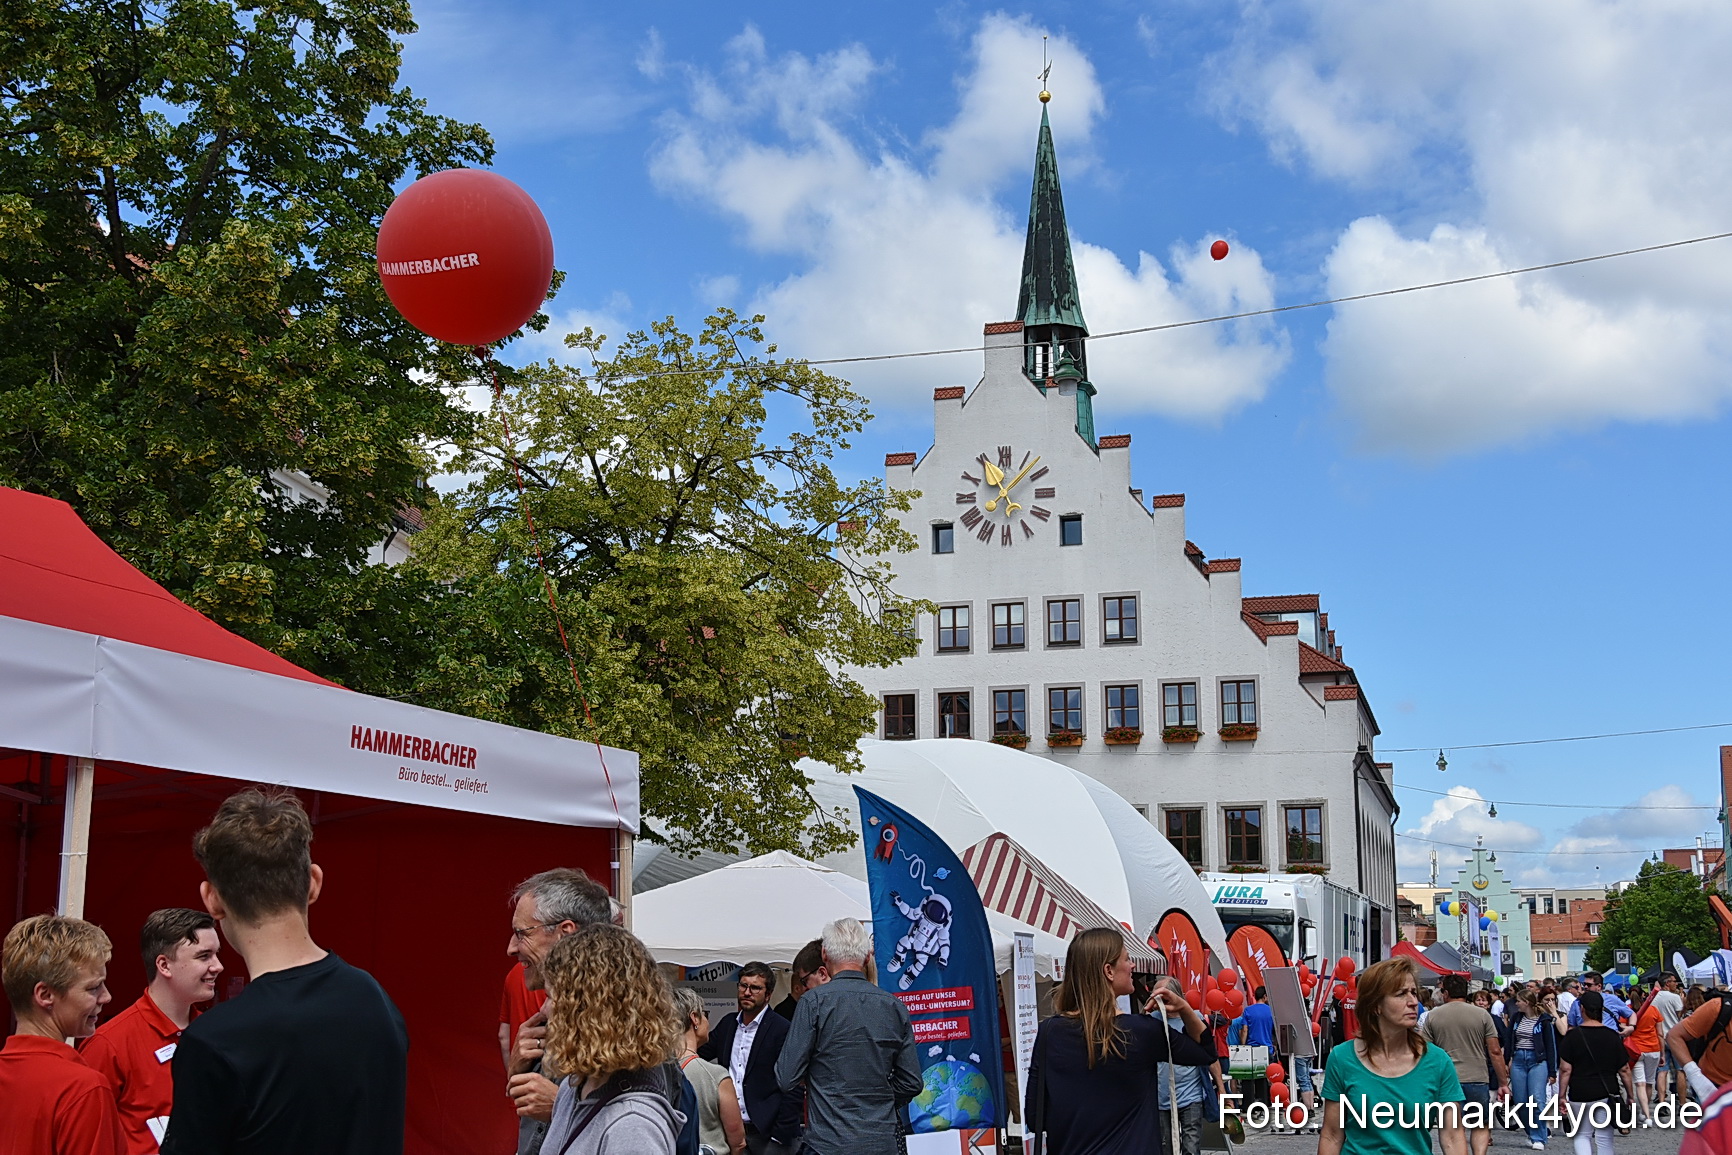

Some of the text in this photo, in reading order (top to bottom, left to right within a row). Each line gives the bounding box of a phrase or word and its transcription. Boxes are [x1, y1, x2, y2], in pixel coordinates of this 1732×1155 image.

[381, 253, 480, 275] HAMMERBACHER
[350, 724, 477, 770] HAMMERBACHER
[398, 766, 489, 794] Büro bestel... geliefert.
[1211, 886, 1263, 904] JURA
[935, 991, 956, 999] UNSER
